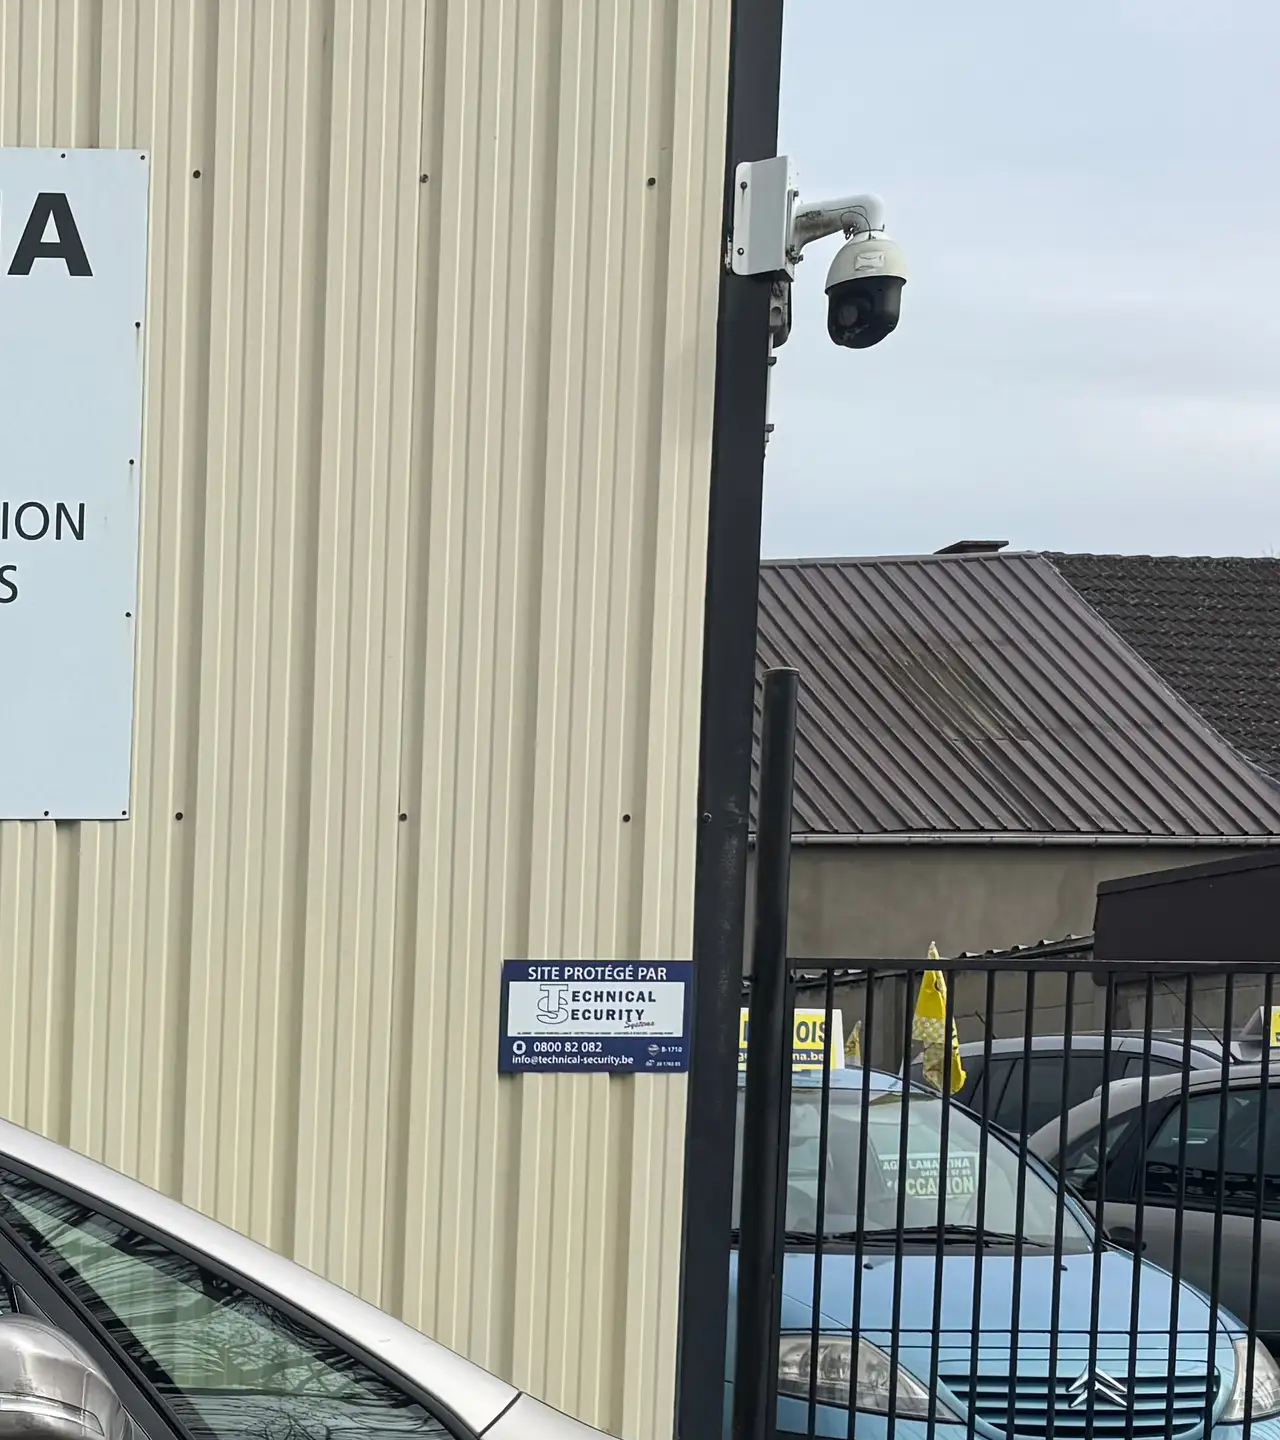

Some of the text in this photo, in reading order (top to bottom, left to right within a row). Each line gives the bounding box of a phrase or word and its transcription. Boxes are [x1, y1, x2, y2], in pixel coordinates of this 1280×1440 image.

[528, 964, 667, 981] SITE PROTÉGÉ PAR
[533, 1042, 602, 1053] 0800 82 082
[512, 1054, 634, 1066] info@technical-security.be
